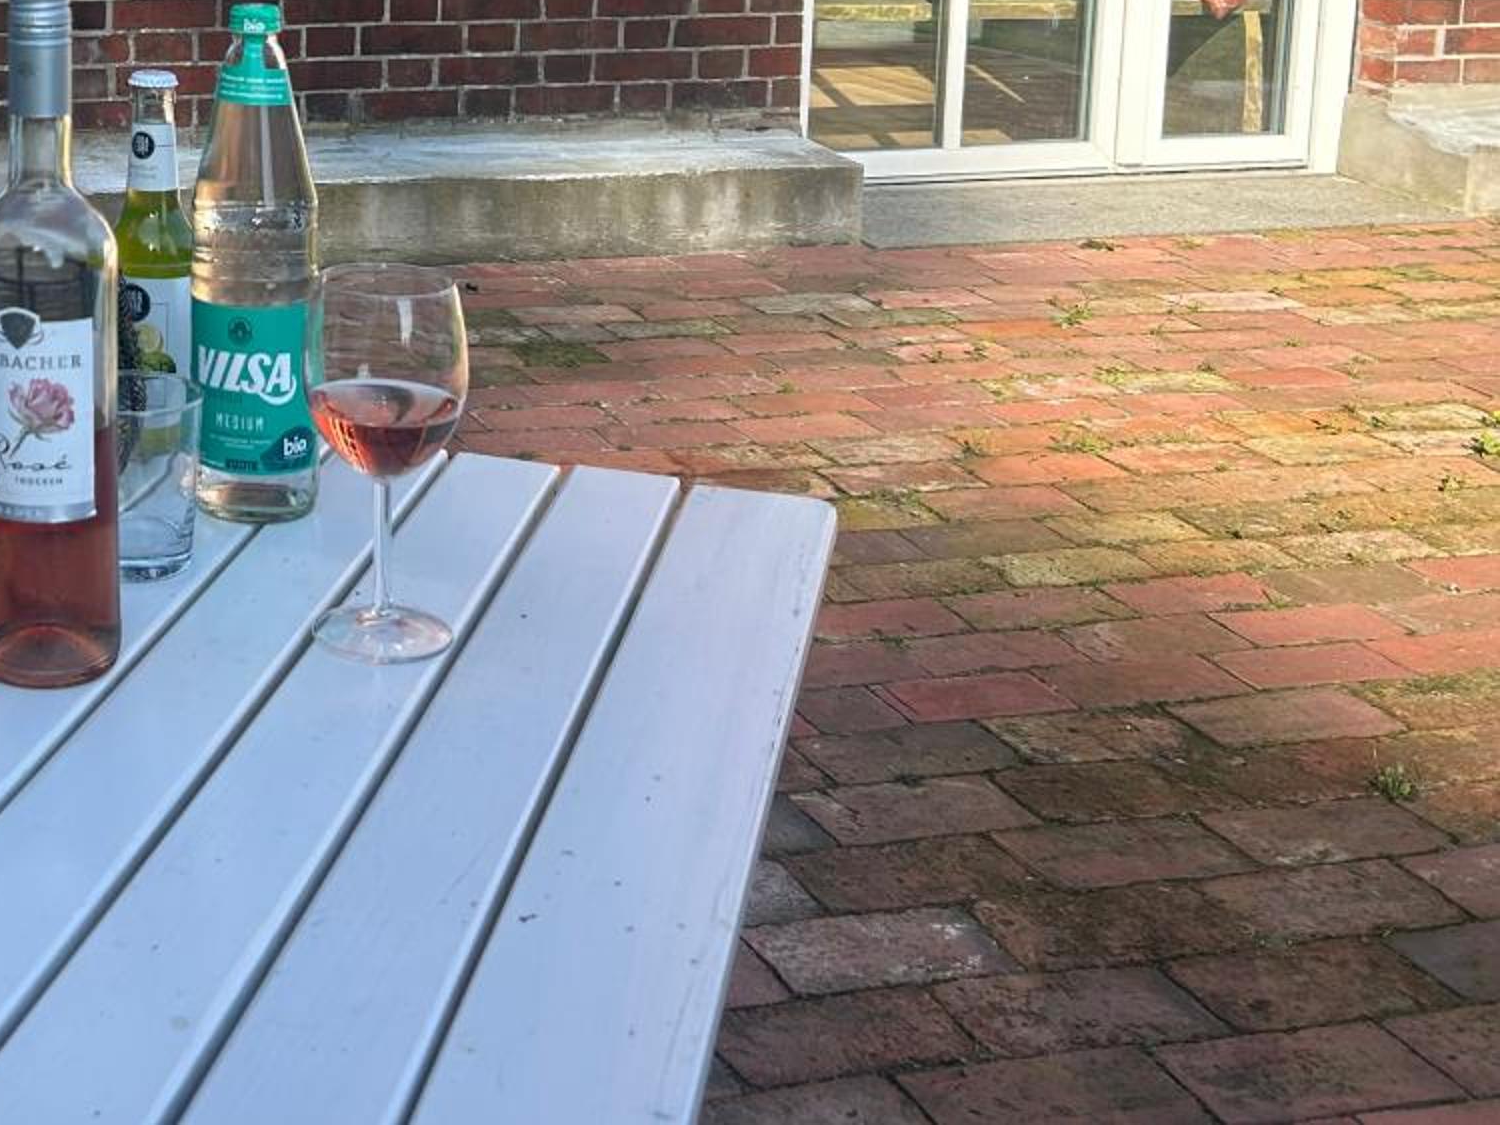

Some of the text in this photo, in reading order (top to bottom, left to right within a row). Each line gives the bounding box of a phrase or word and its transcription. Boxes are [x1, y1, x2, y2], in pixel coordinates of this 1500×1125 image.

[198, 345, 293, 397] VILSA
[215, 413, 264, 431] MEDIUM
[283, 436, 307, 456] bio
